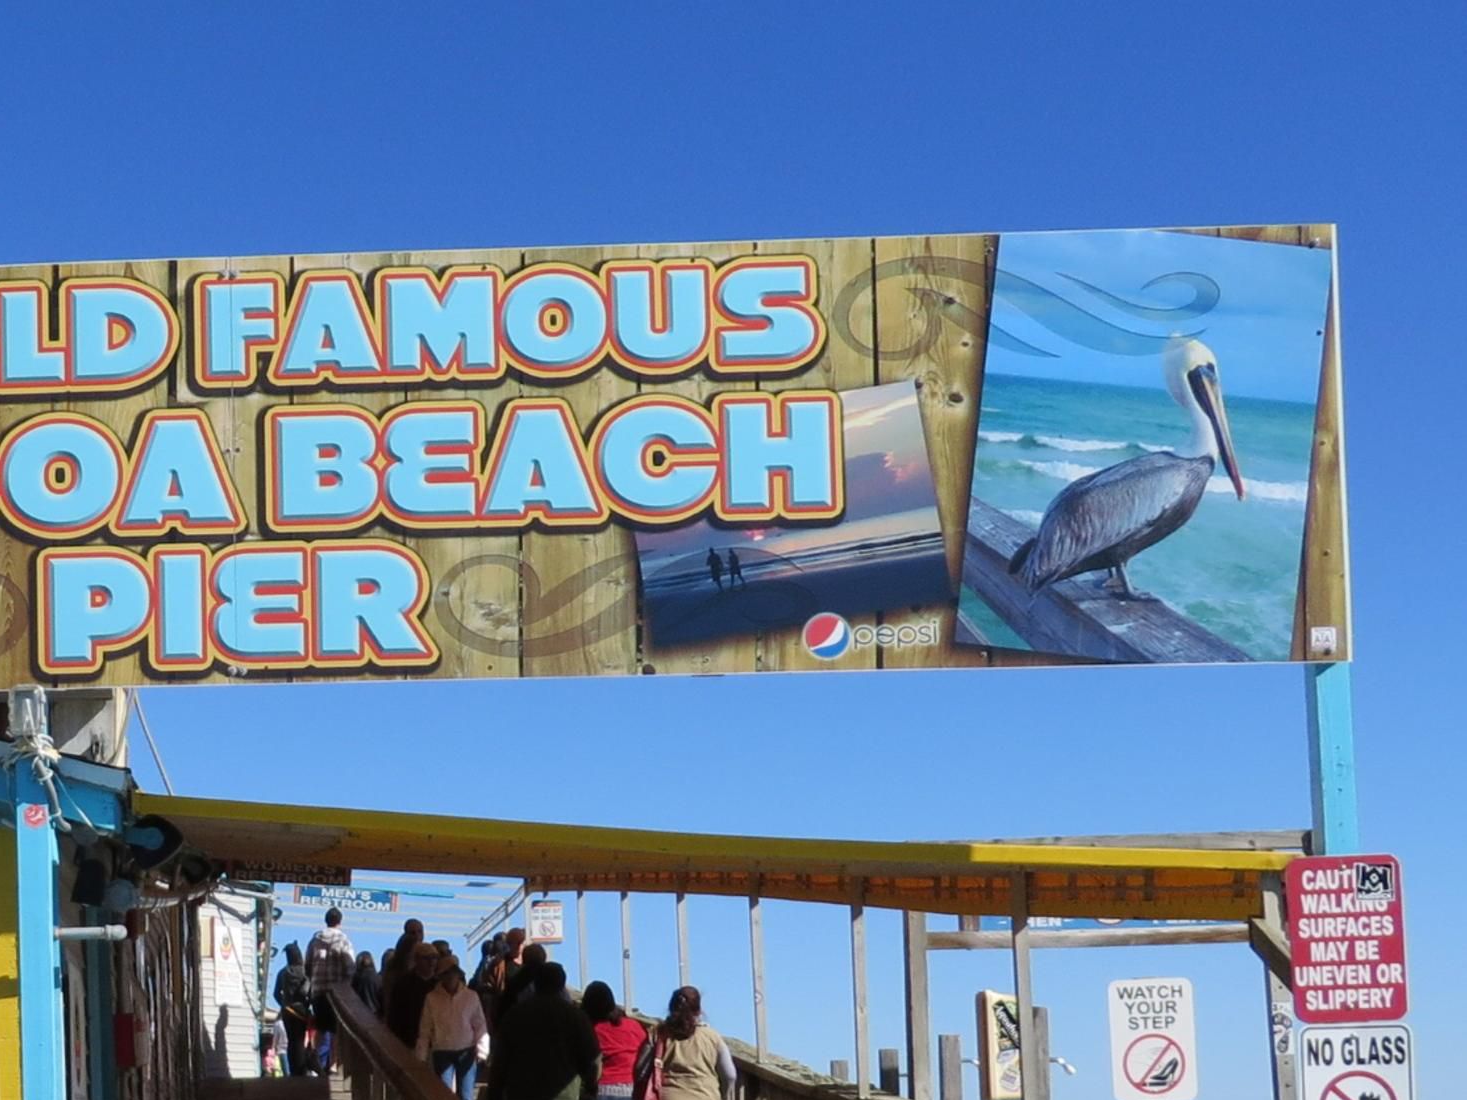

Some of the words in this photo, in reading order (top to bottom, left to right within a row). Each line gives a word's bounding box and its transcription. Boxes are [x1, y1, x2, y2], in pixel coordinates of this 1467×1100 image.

[199, 257, 822, 385] FAMOUS
[269, 389, 842, 532] BEACH
[39, 540, 439, 673] PIER
[851, 618, 939, 649] pepsi
[1302, 869, 1366, 891] CAUT
[300, 896, 391, 912] RESTROOM
[320, 887, 371, 899] MEN'S
[1298, 915, 1394, 939] SURFACES
[1310, 941, 1349, 962] MAY
[1355, 940, 1380, 960] BE
[1294, 964, 1372, 987] UNEVEN
[1376, 963, 1404, 984] OR
[1117, 985, 1183, 1001] WATCH
[1306, 988, 1394, 1011] SLIPPERY
[1124, 1001, 1177, 1015] YOUR
[1128, 1016, 1176, 1030] STEP
[1307, 1037, 1335, 1066] NO
[1340, 1036, 1406, 1065] GLASS
